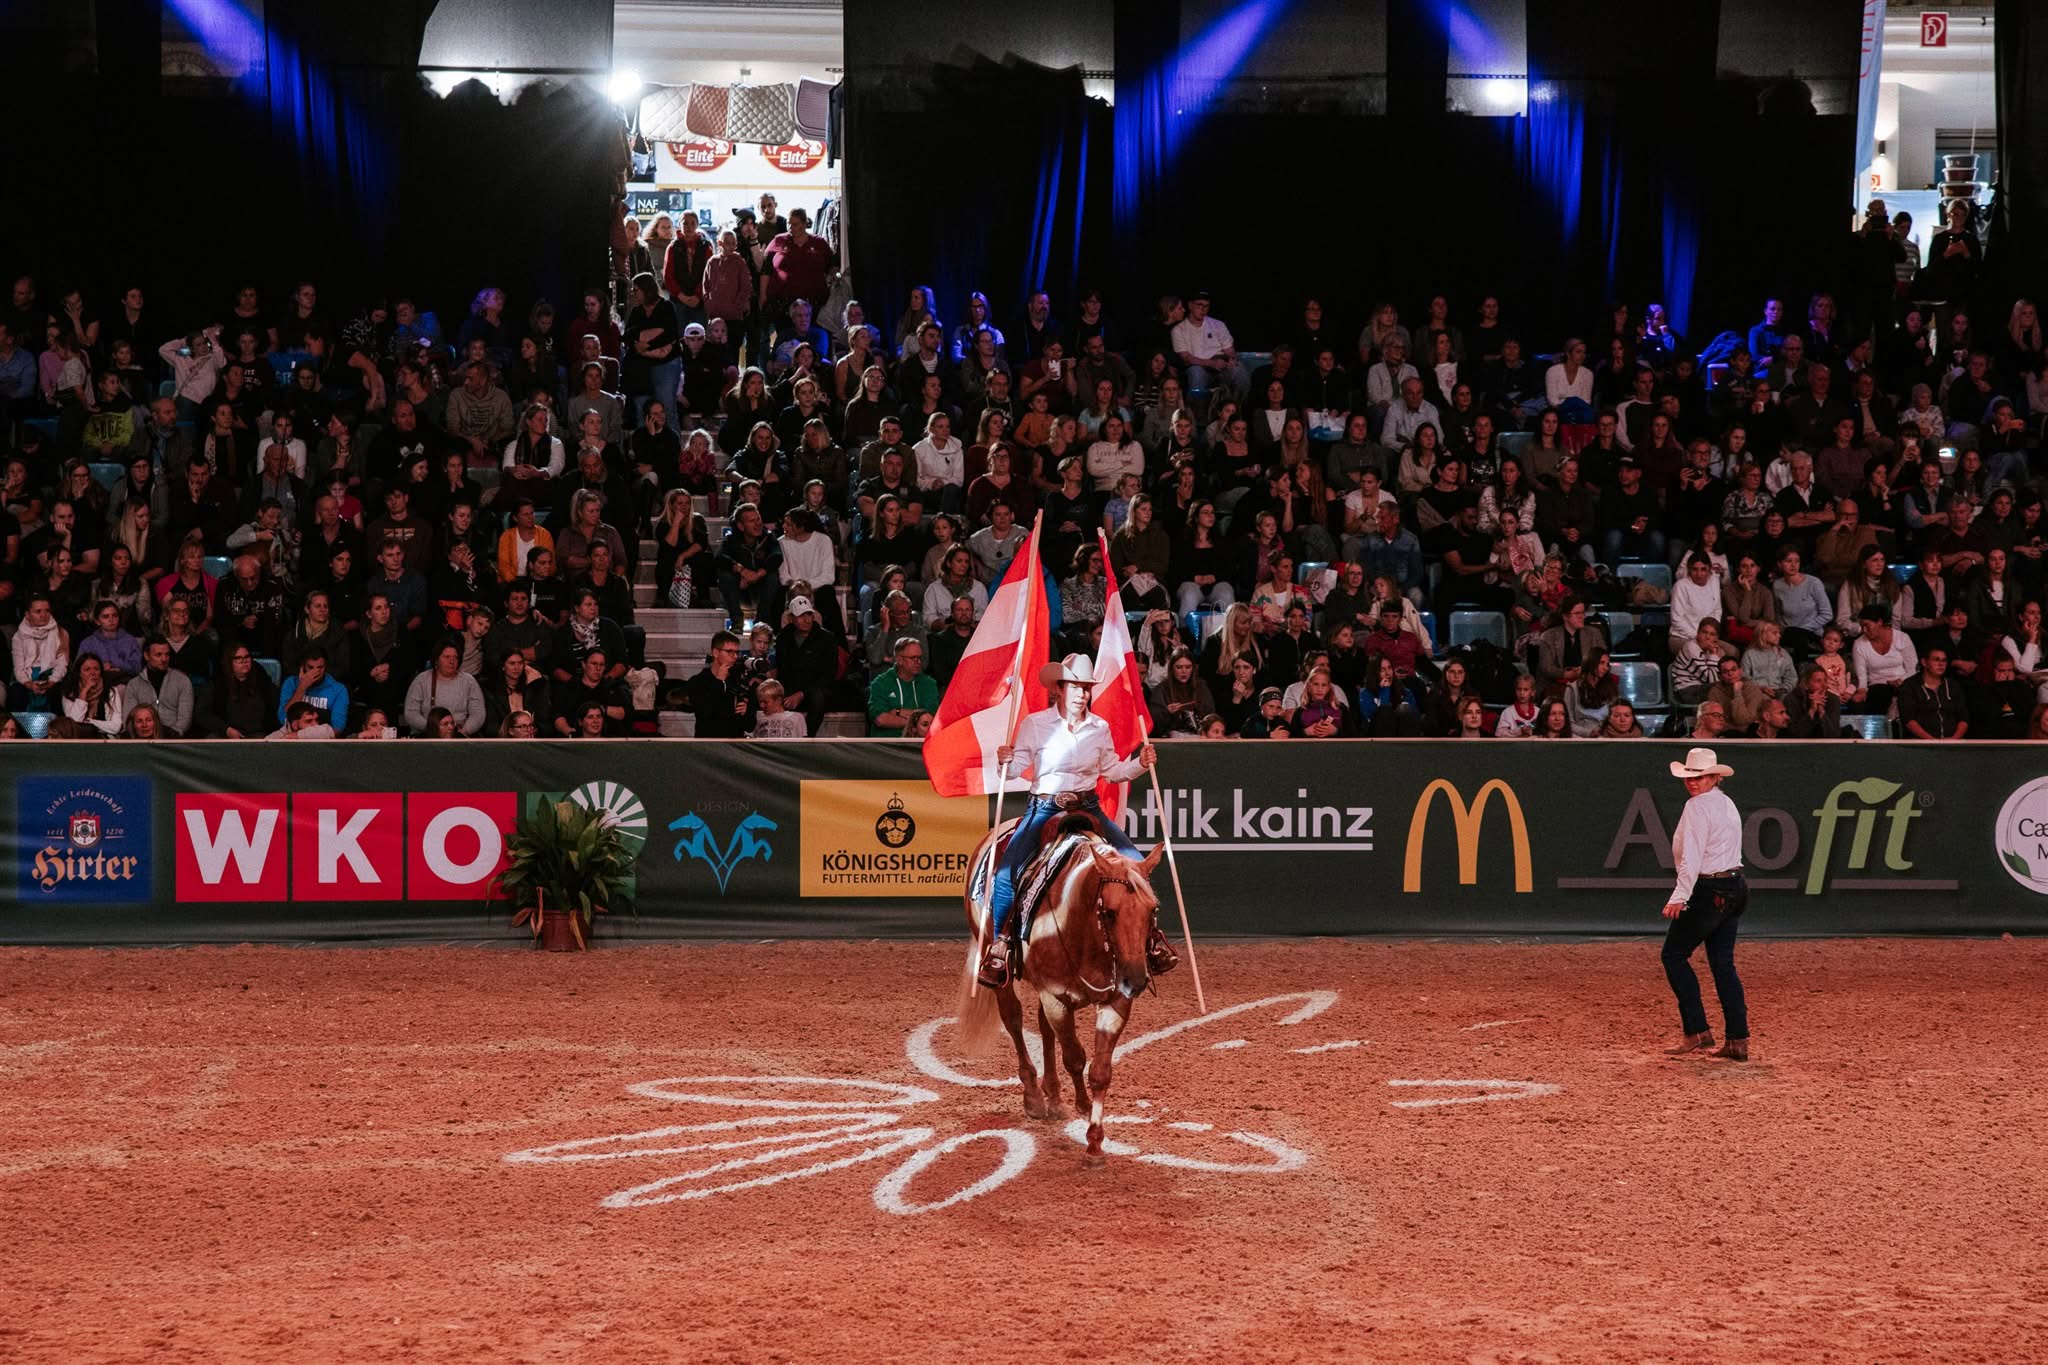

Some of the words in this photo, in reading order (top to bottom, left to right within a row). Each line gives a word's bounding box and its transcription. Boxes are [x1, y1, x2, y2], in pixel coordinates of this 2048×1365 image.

[637, 199, 659, 209] NAF
[69, 788, 124, 815] Leidenschaft
[696, 800, 751, 812] DESIGN
[1233, 788, 1373, 838] kainz
[47, 827, 64, 835] seit
[105, 827, 124, 836] 1270
[1604, 777, 1922, 895] Aofit
[183, 806, 502, 885] WKO
[31, 845, 138, 893] Hirter
[822, 850, 968, 871] KÖNIGSHOFER
[822, 873, 914, 884] FUTTERMITTEL
